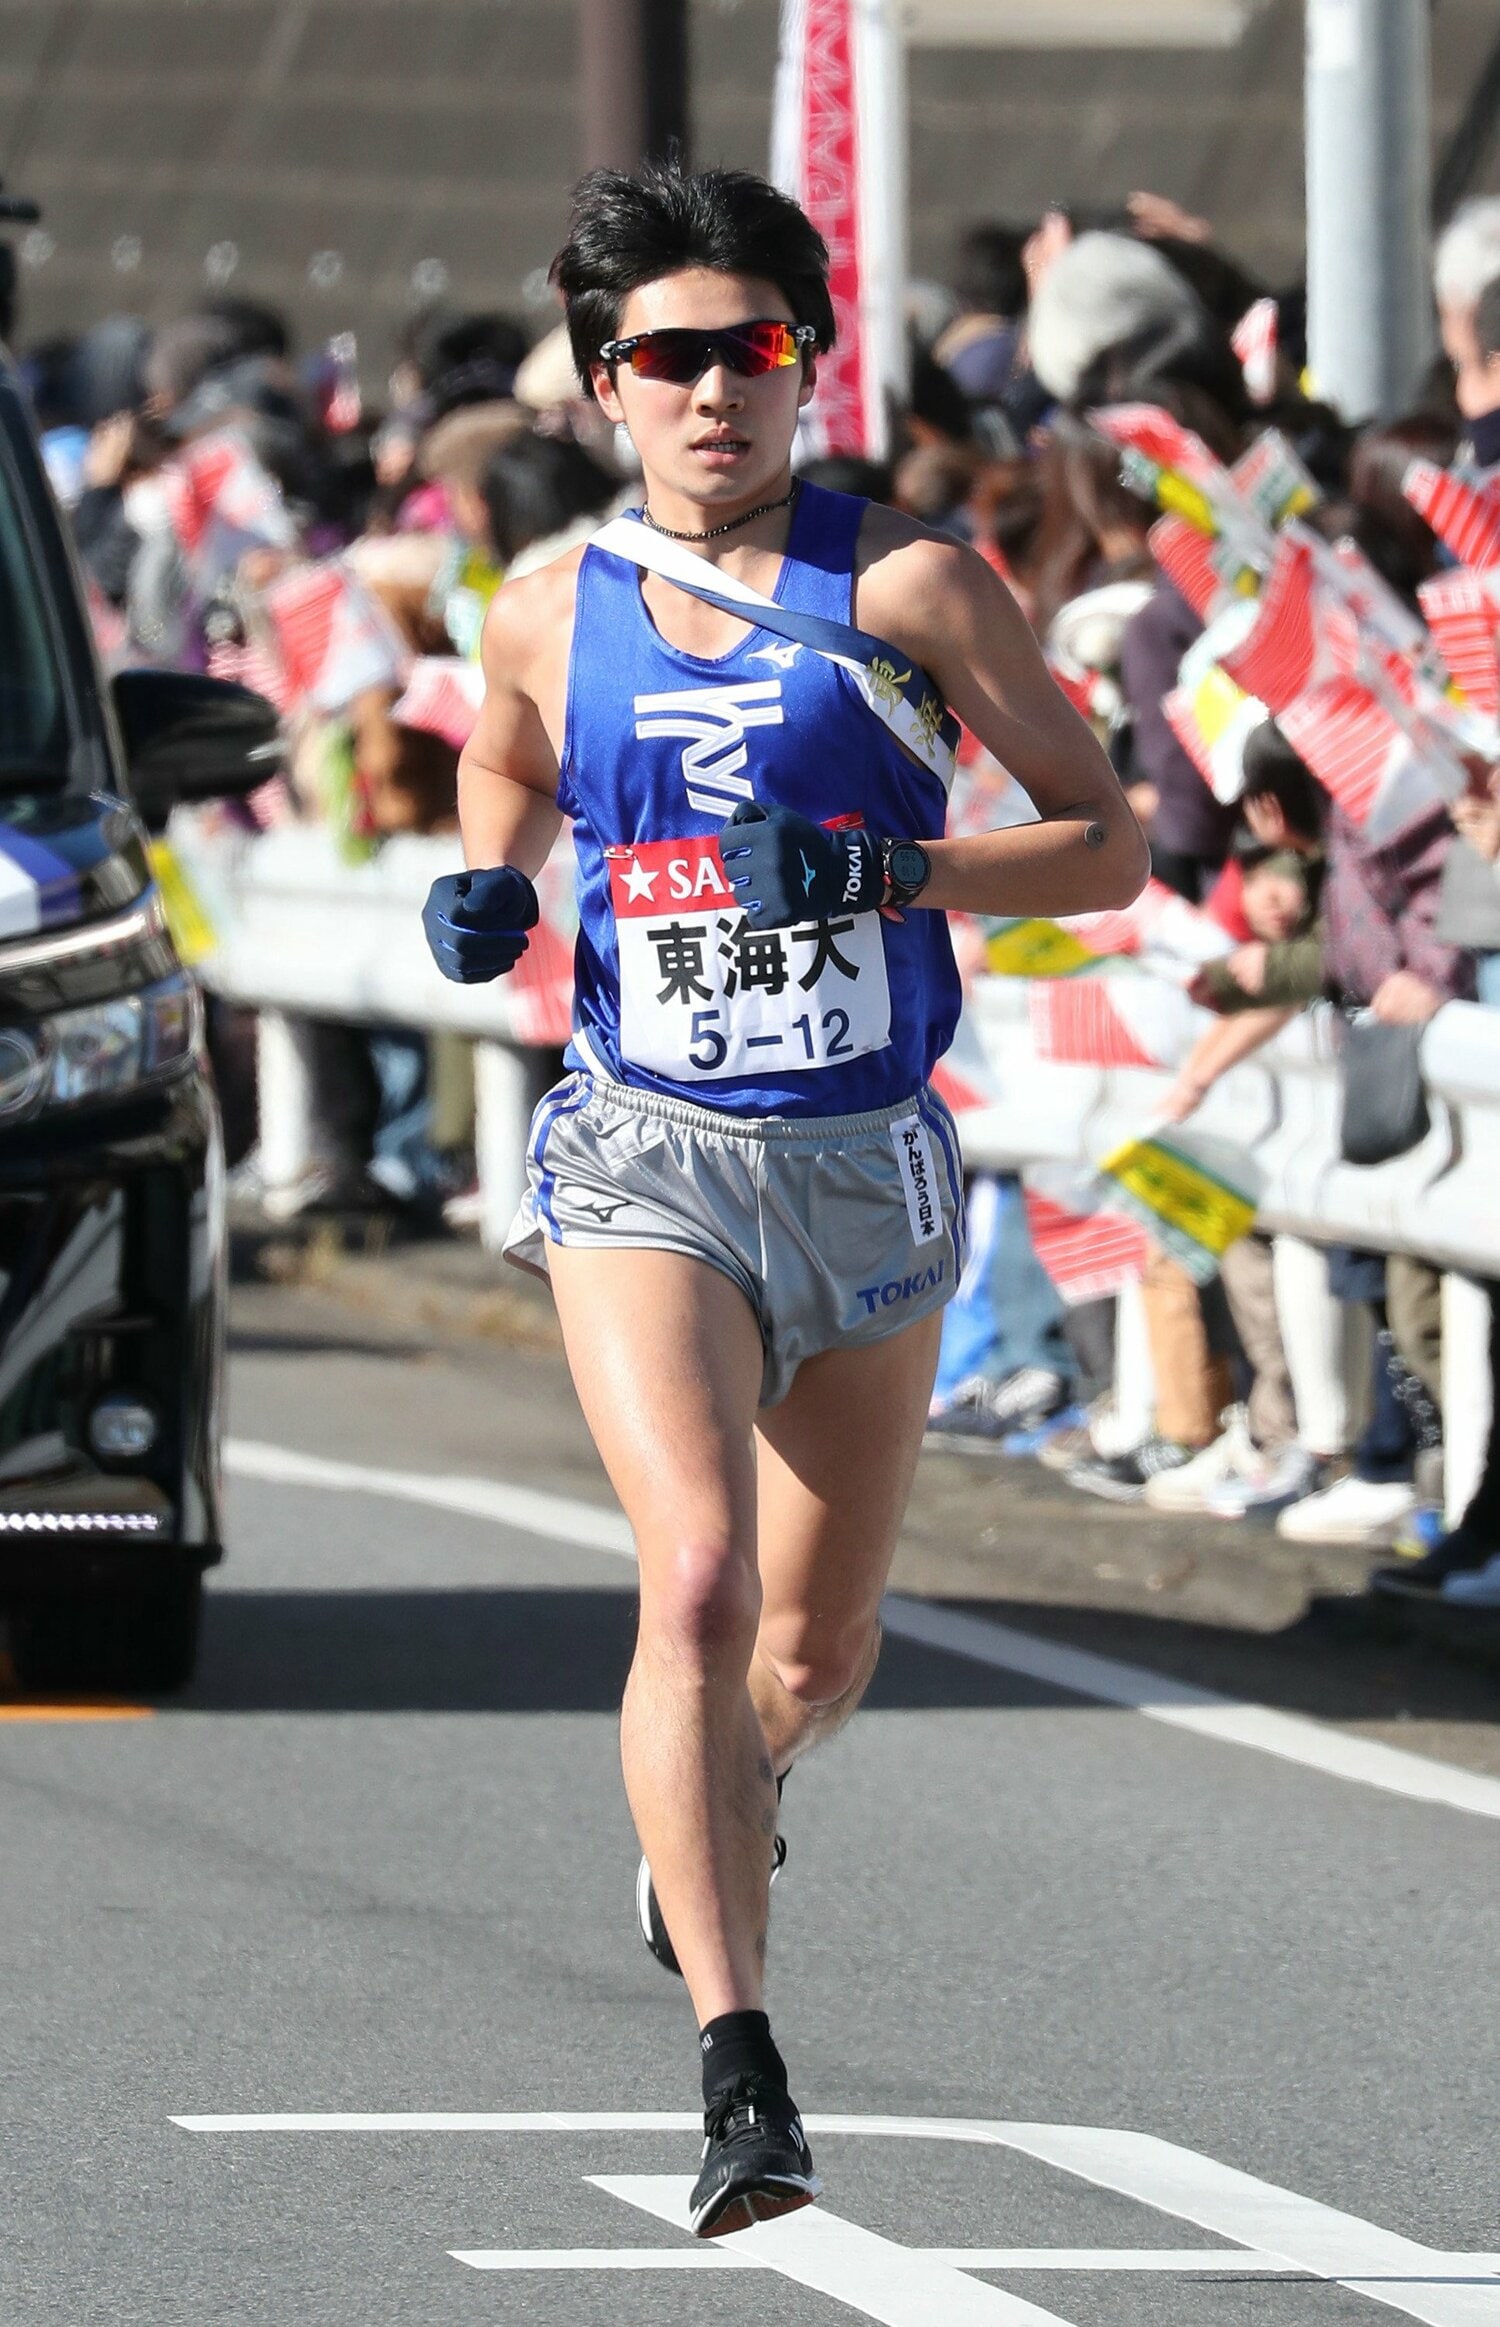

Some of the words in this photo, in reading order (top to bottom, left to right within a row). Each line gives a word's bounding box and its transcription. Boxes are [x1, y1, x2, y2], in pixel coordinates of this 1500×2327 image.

[668, 857, 735, 899] SA
[842, 845, 862, 903] TOKAI
[647, 917, 860, 1005] 東海大
[902, 1129, 935, 1237] がんばろう日本
[856, 1259, 944, 1314] TOKAI
